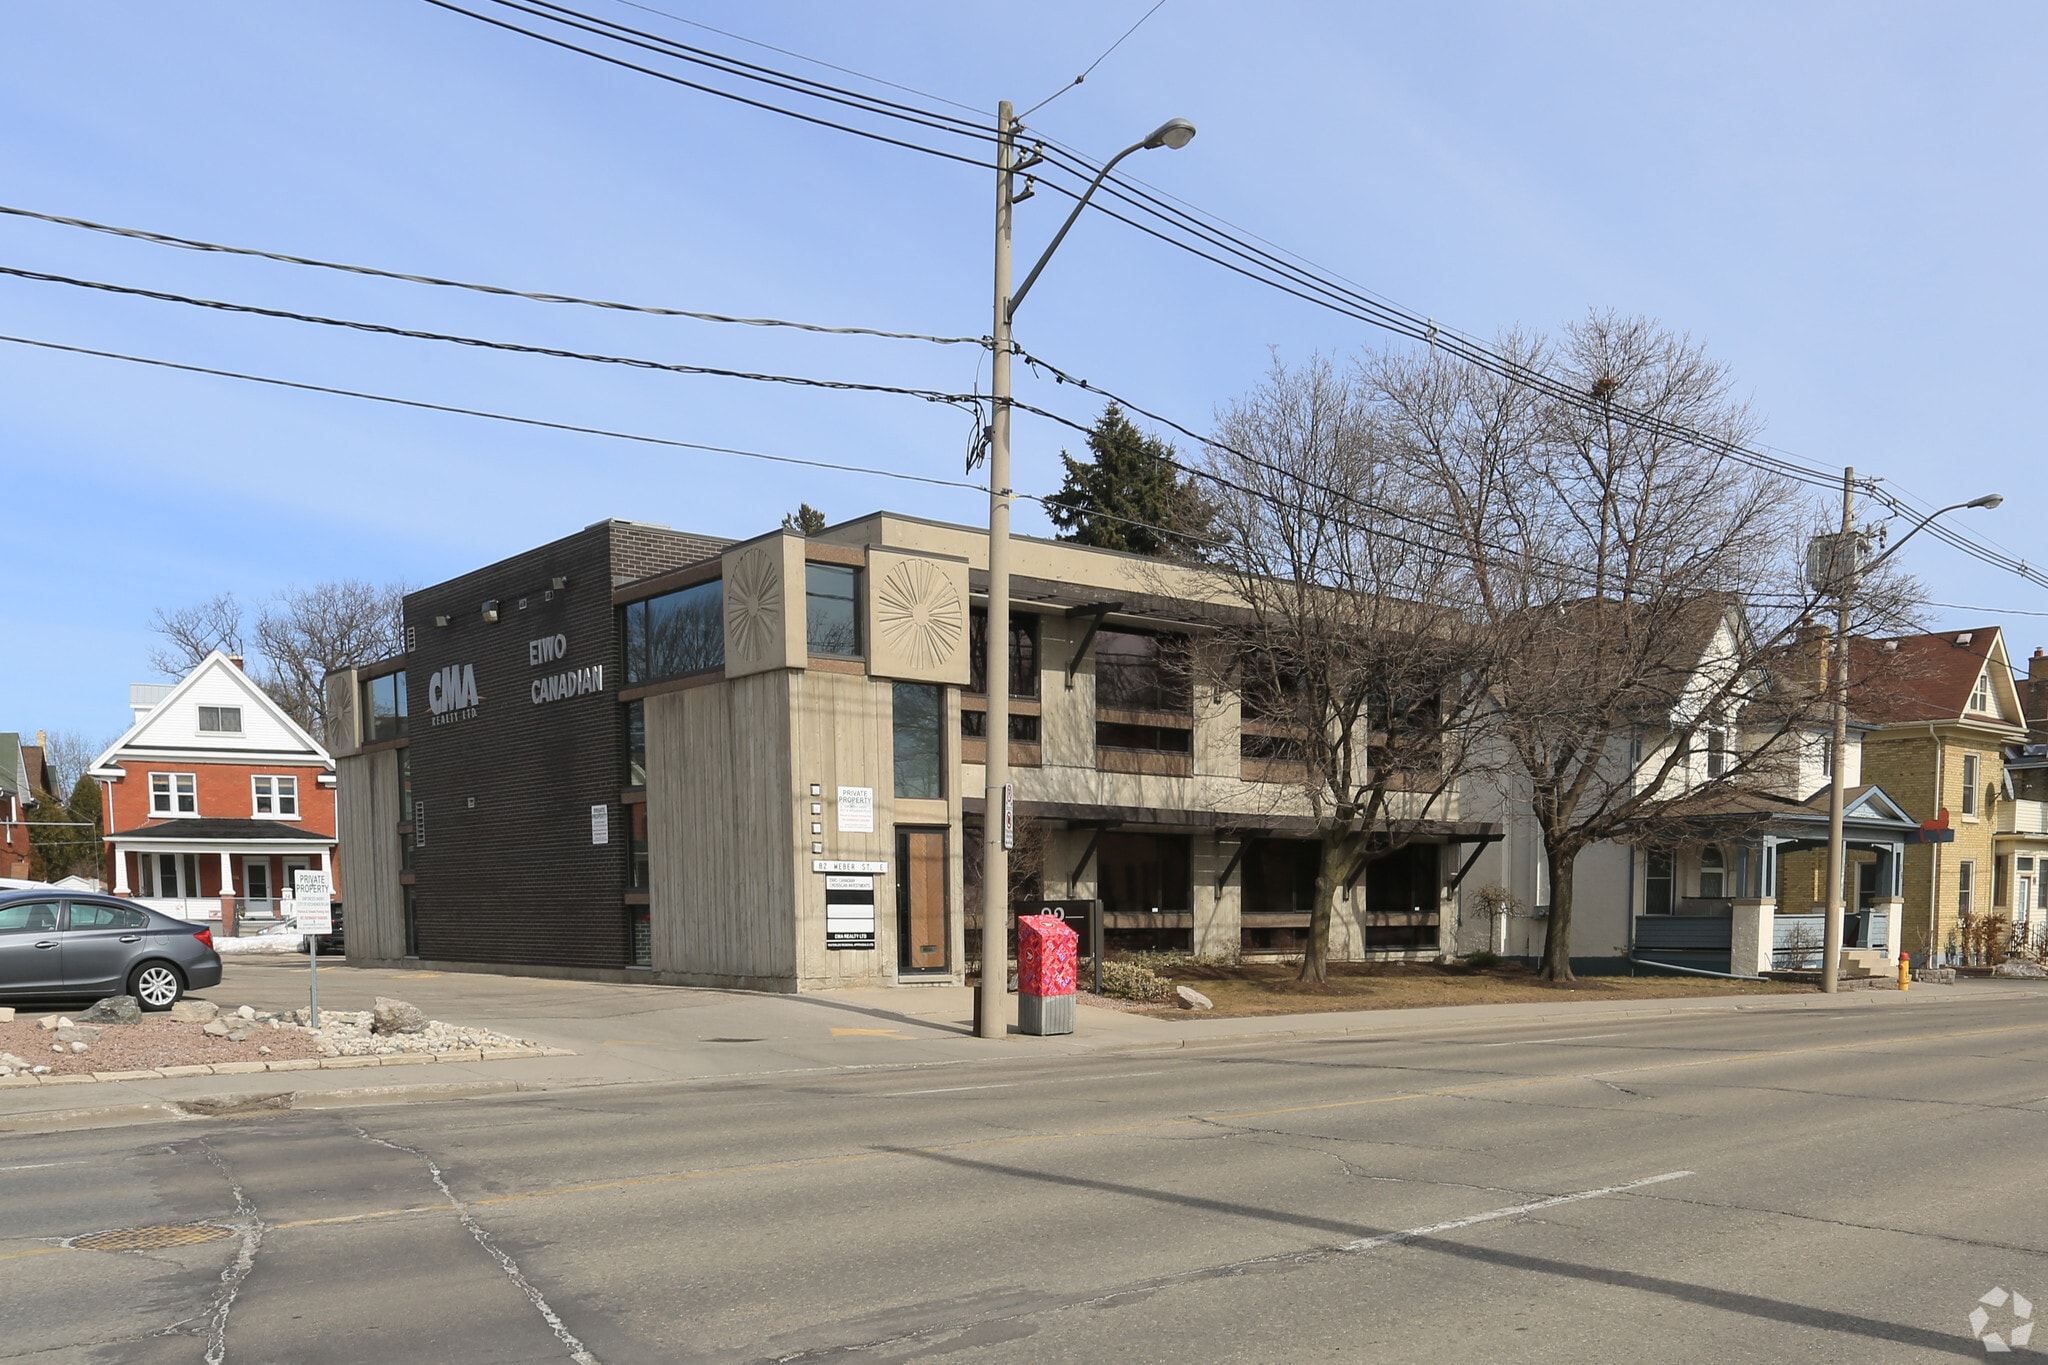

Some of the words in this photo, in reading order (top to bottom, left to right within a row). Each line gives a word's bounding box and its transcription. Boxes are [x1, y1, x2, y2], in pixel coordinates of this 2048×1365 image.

[529, 633, 567, 666] EIWO
[428, 663, 479, 715] CMA
[531, 664, 603, 704] CANADIAN
[431, 711, 460, 726] REALTY
[842, 789, 868, 798] PRIVATE
[838, 796, 872, 804] PROPERTY
[833, 862, 856, 871] WEBER
[299, 874, 326, 884] PRIVATE
[296, 884, 329, 893] PROPERTY
